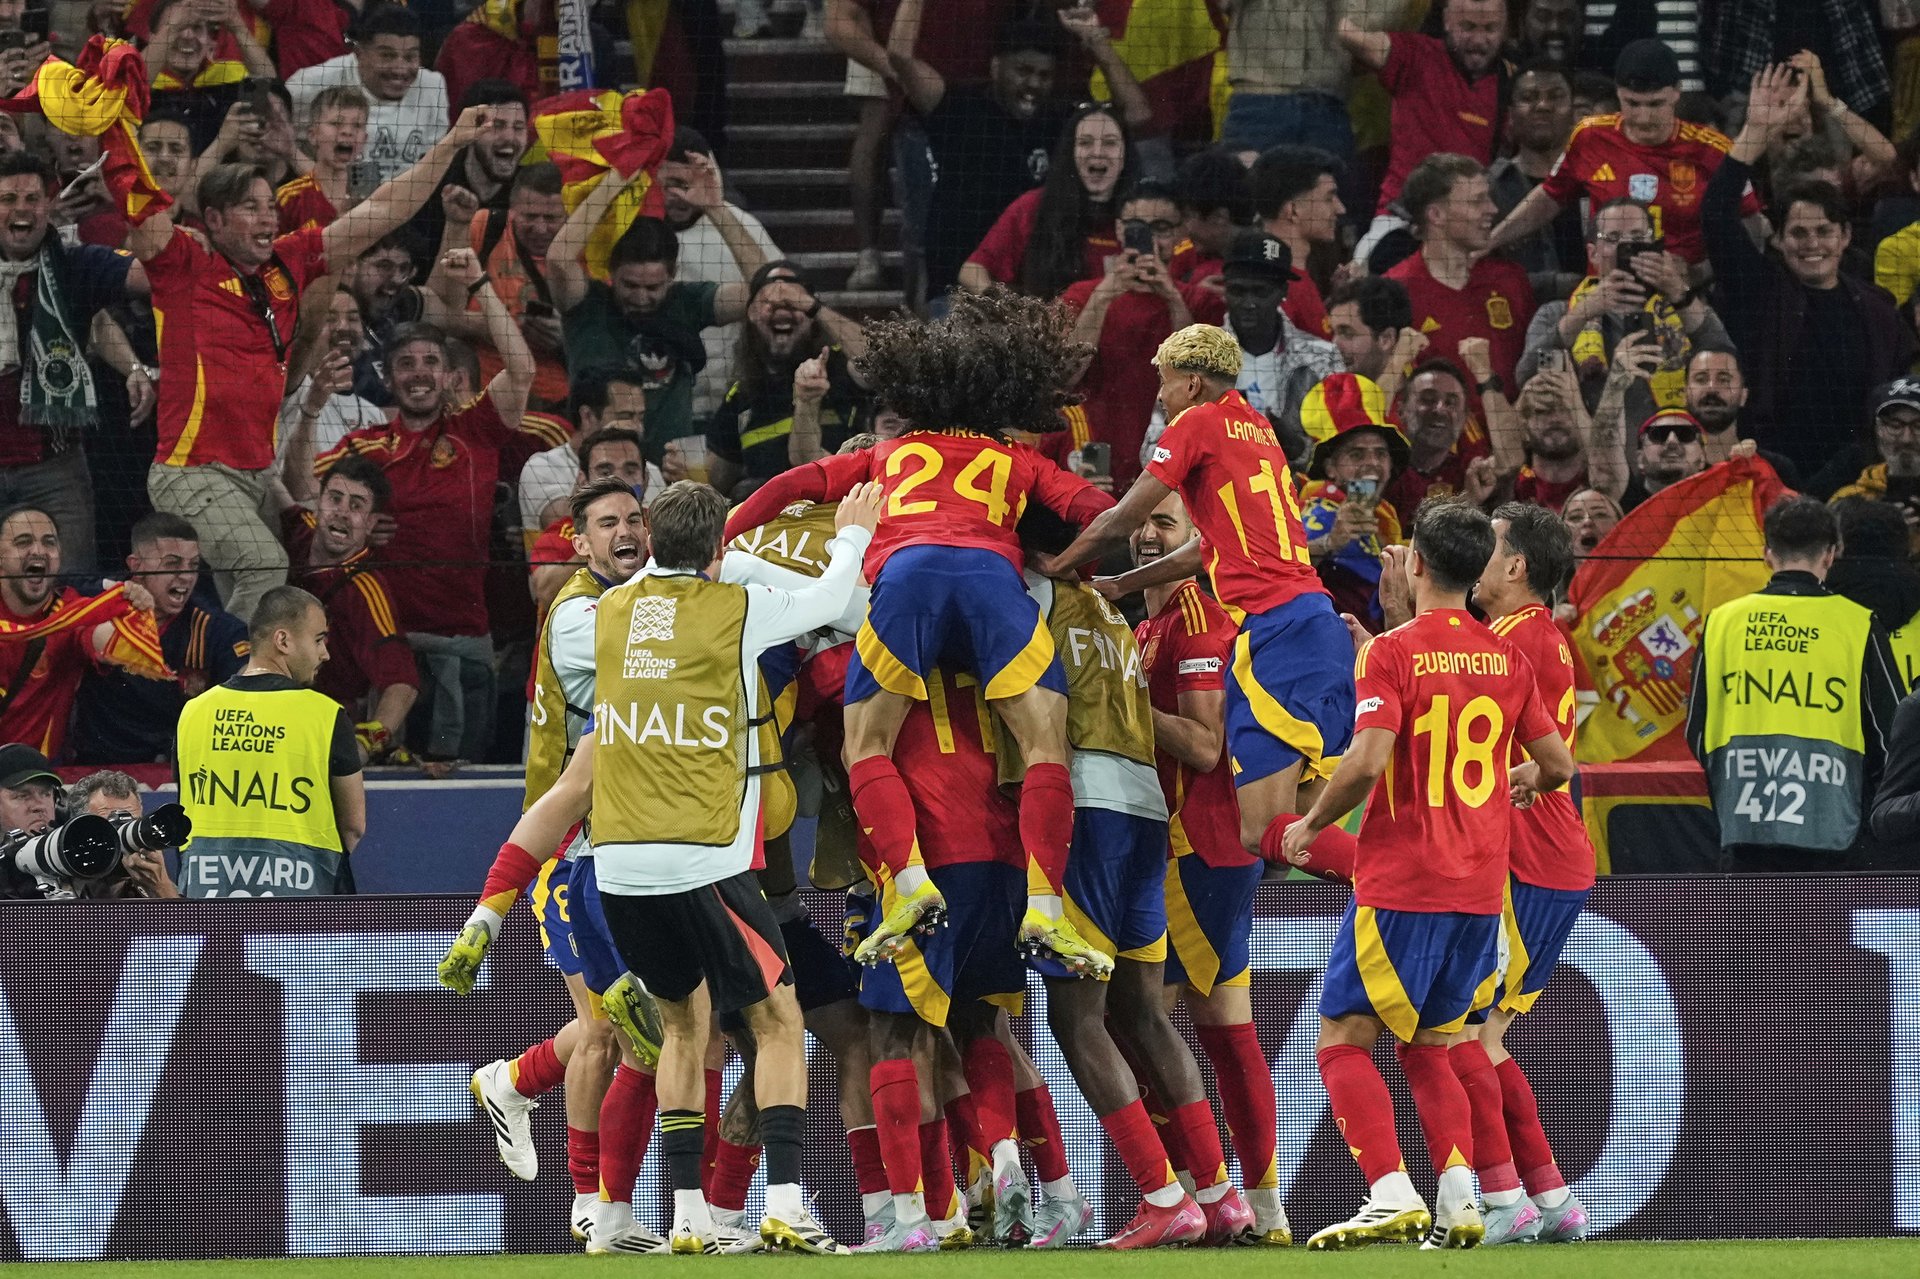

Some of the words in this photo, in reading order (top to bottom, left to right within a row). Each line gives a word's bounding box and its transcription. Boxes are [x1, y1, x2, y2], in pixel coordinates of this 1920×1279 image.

[886, 442, 1012, 527] 24
[1249, 459, 1311, 565] 19
[729, 525, 835, 572] NAL
[1748, 612, 1787, 624] UEFA
[1746, 624, 1819, 640] NATIONS
[630, 649, 653, 658] UEFA
[1745, 639, 1809, 653] LEAGUE
[623, 668, 668, 679] LEAGUE
[624, 658, 677, 669] NATIONS
[1412, 651, 1509, 677] ZUBIMENDI
[215, 709, 254, 723] UEFA
[594, 701, 731, 748] FINALS
[213, 723, 285, 739] NATIONS
[212, 738, 275, 753] LEAGUE
[1413, 694, 1504, 808] 18
[1725, 748, 1847, 786] TEWARD
[1734, 780, 1807, 825] 422
[188, 855, 314, 890] TEWARD
